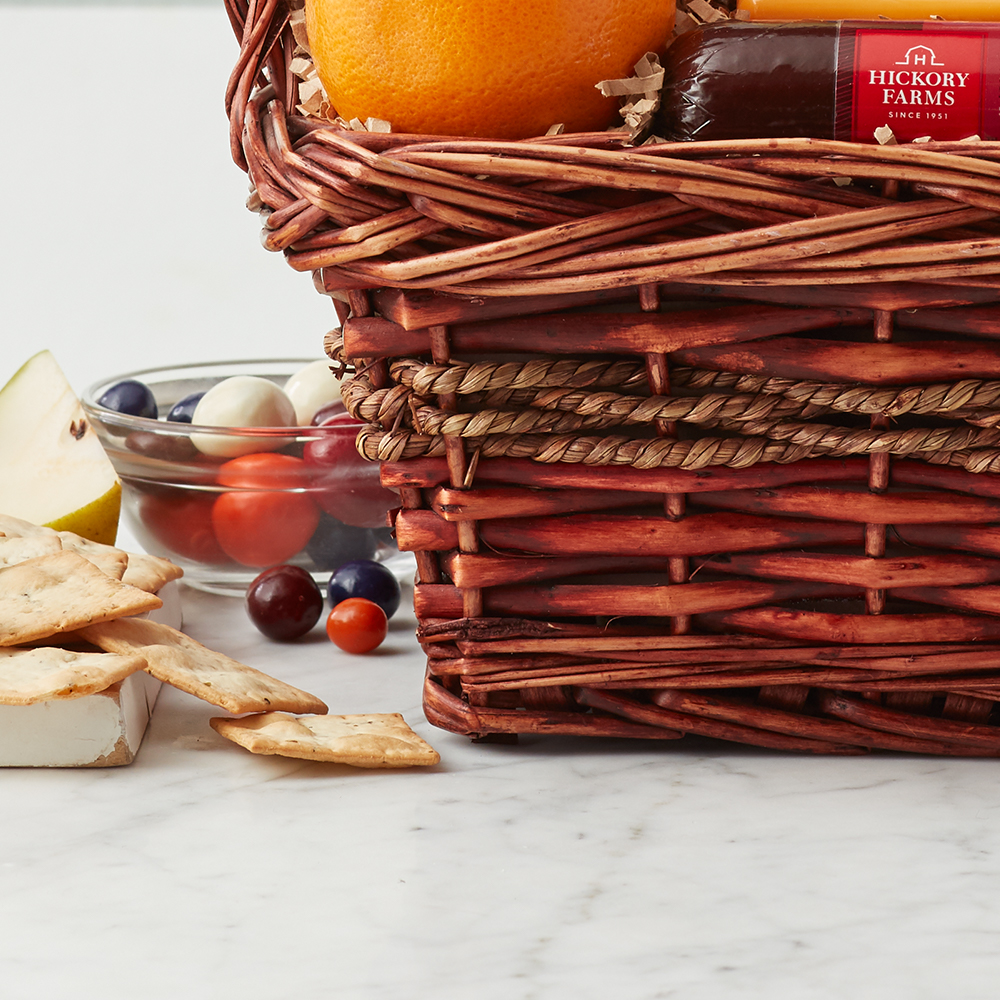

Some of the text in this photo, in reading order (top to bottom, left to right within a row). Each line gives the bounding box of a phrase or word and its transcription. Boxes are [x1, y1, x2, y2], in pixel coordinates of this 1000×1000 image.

[868, 70, 970, 87] HICKORY
[882, 89, 955, 106] FARMS
[888, 111, 948, 120] SINCE 1951
